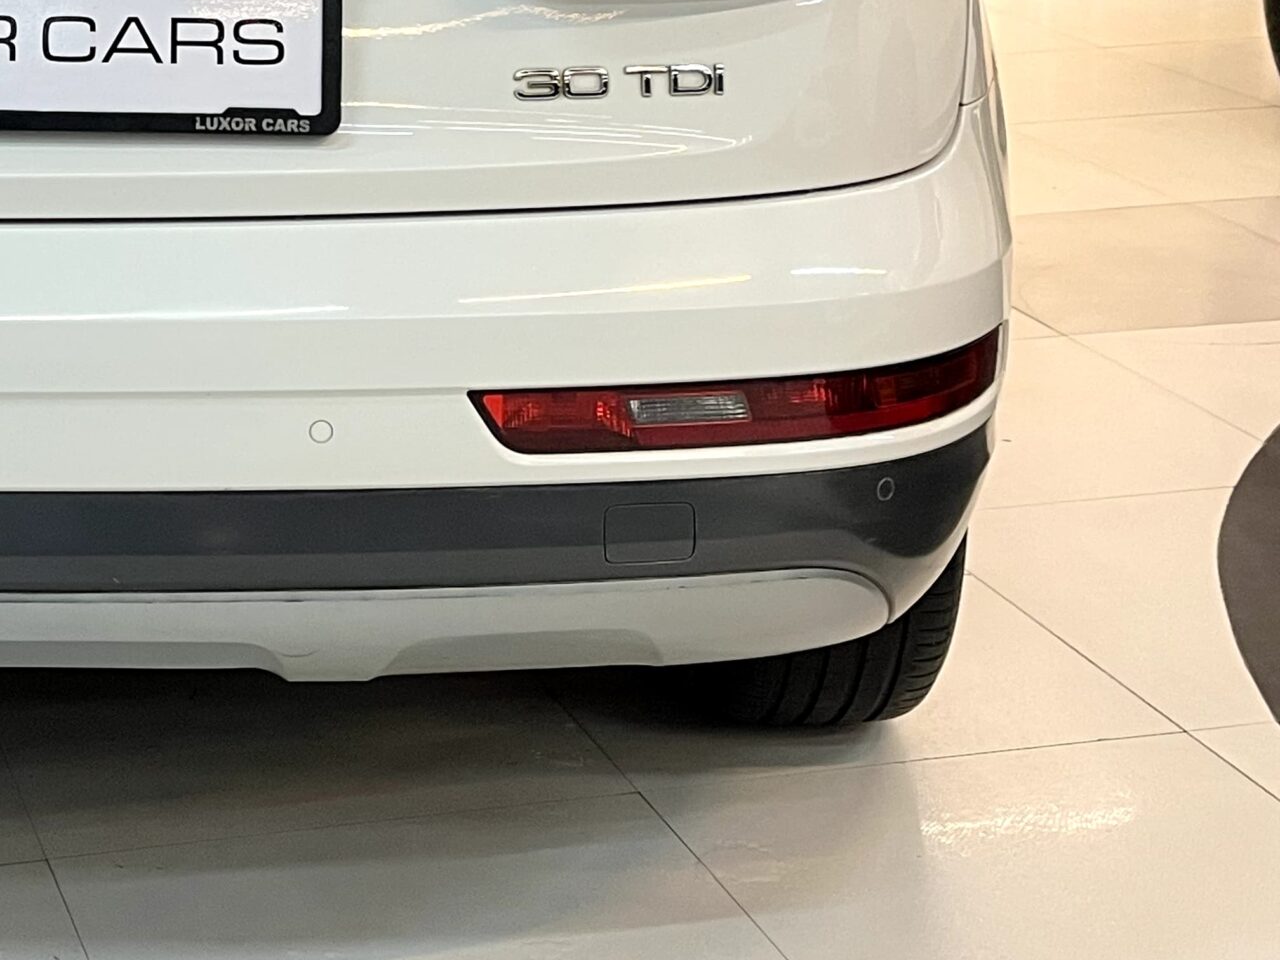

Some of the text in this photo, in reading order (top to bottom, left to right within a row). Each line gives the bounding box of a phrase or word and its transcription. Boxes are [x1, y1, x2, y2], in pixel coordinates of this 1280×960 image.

[41, 15, 285, 65] CARS
[513, 66, 609, 101] 30
[195, 116, 311, 133] LUXOR CARS
